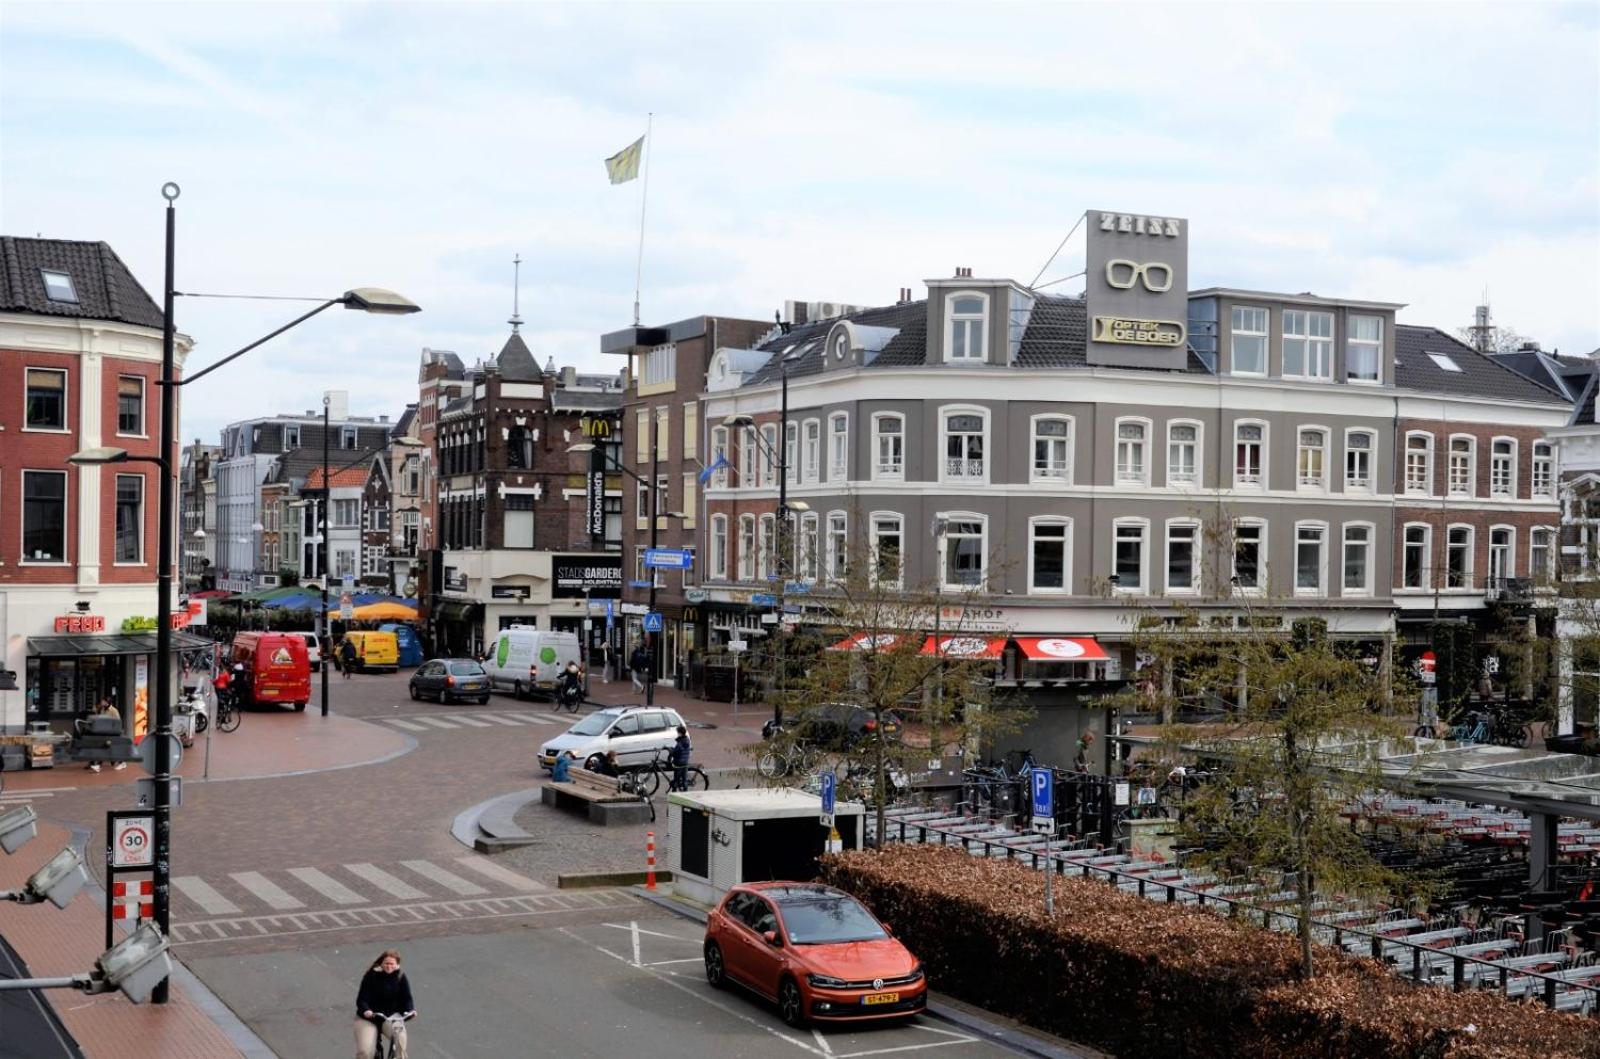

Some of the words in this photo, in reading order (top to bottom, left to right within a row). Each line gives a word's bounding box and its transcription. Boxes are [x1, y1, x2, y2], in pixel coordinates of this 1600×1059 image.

[1100, 212, 1180, 237] ZEISS
[1138, 331, 1179, 344] BOER
[593, 471, 603, 534] McDonald's
[1035, 773, 1047, 797] P
[125, 836, 143, 847] 30
